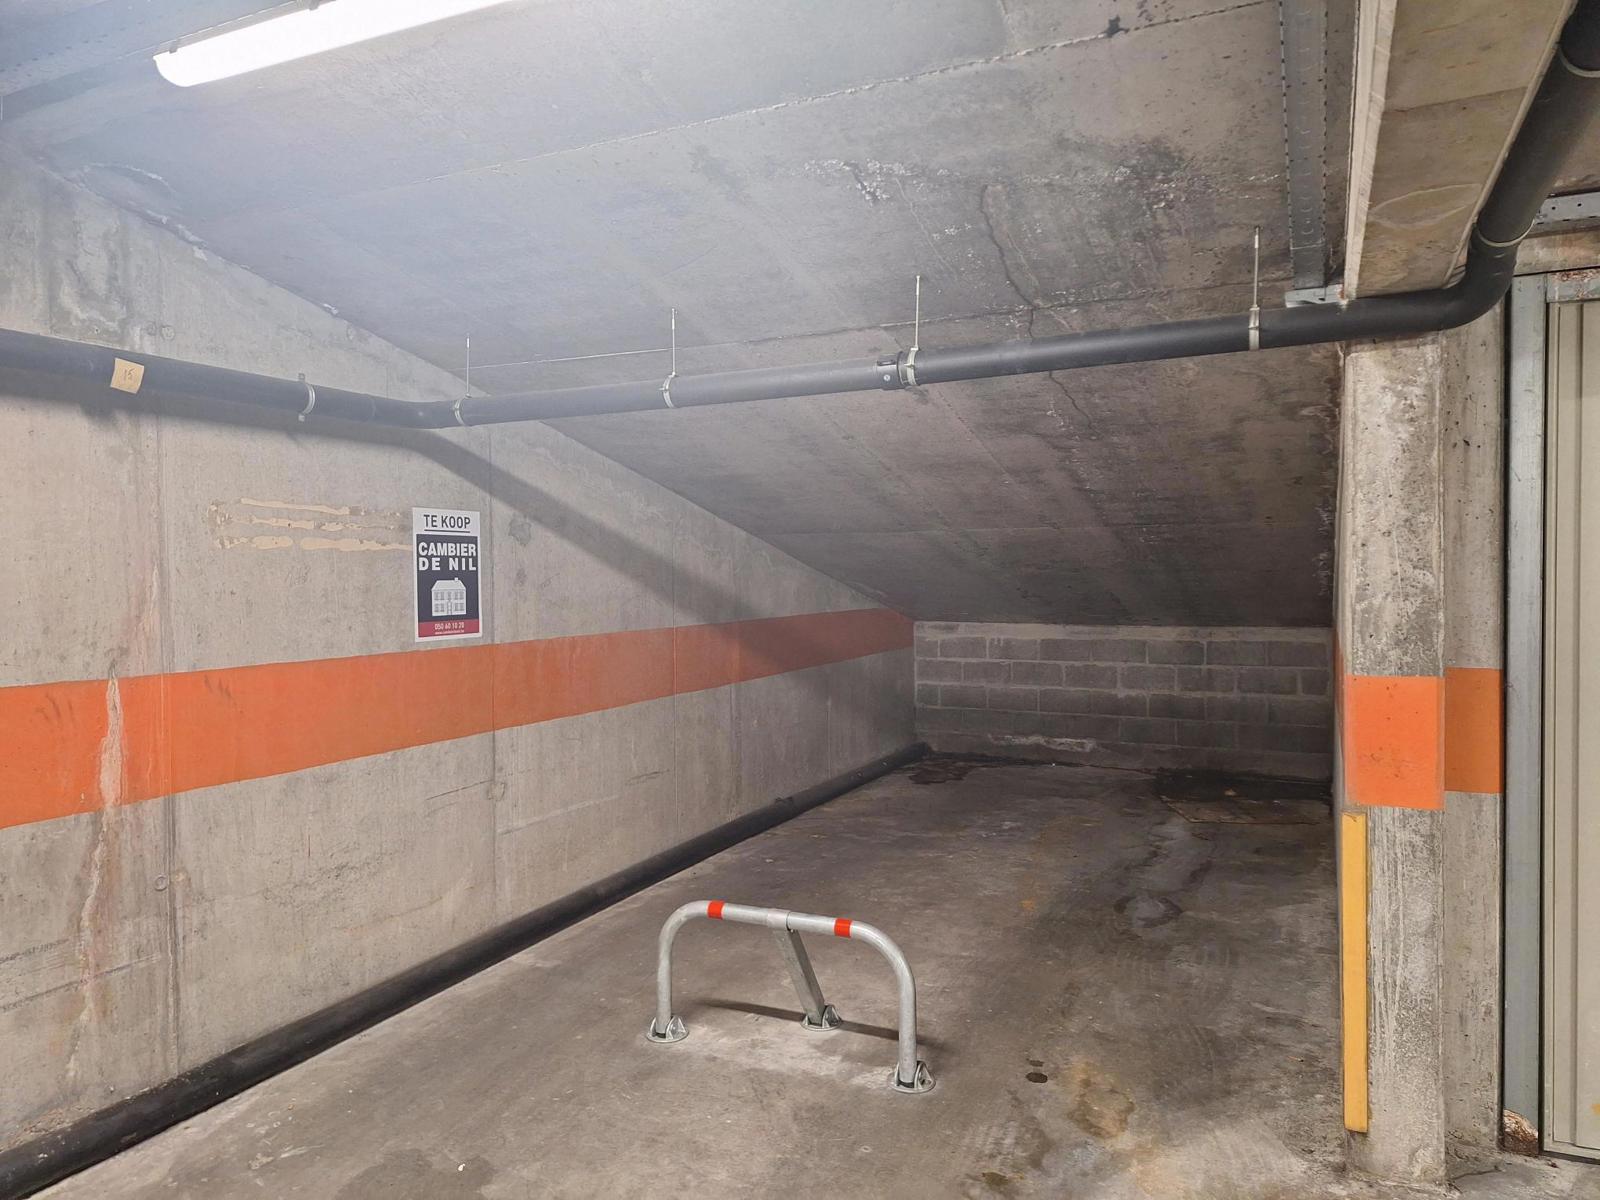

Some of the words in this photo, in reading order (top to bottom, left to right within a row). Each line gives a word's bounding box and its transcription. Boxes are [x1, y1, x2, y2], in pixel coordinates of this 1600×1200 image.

[423, 514, 438, 528] TE
[441, 515, 471, 529] KOOP
[418, 541, 477, 557] CAMBIER
[418, 557, 441, 571] DE
[448, 557, 477, 571] NIL
